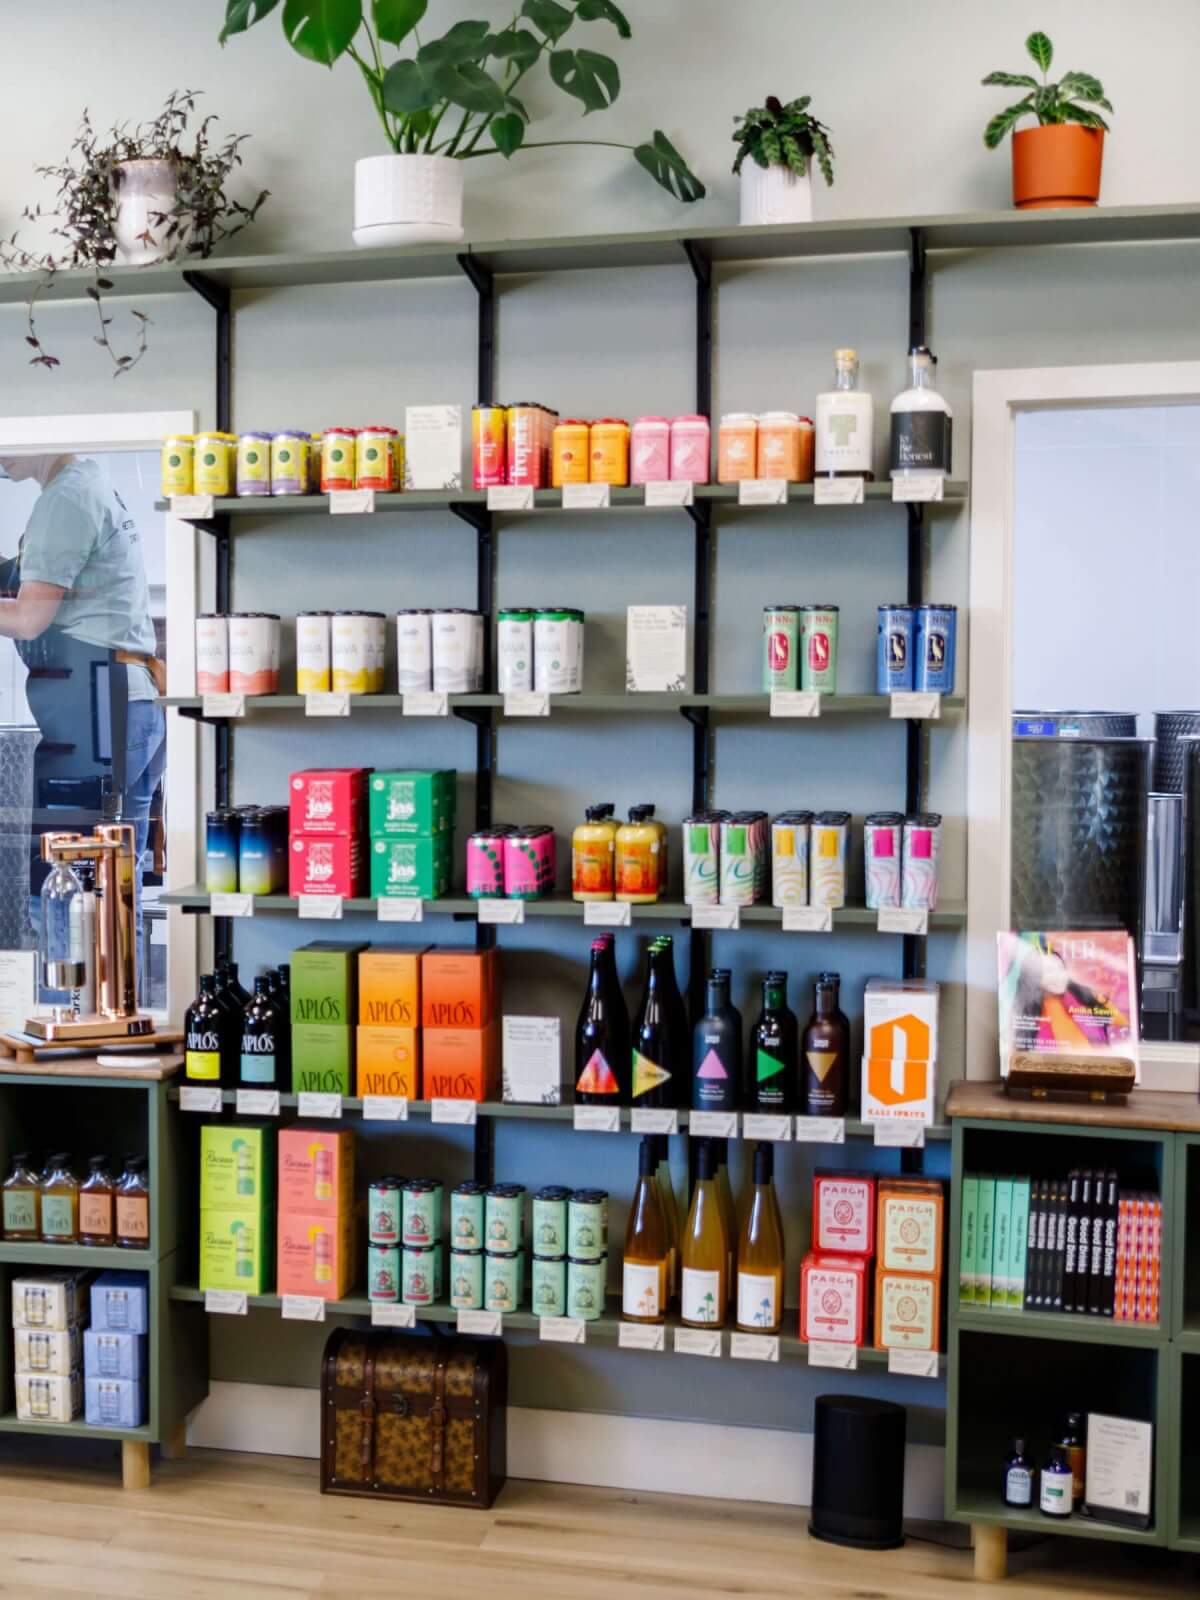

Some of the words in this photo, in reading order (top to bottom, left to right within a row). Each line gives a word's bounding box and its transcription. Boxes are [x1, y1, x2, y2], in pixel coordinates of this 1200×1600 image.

[1066, 1216, 1078, 1243] Good
[1079, 1217, 1090, 1244] Good
[1092, 1218, 1103, 1245] Good
[1105, 1220, 1115, 1247] Good
[1065, 1244, 1076, 1273] Drinks
[1078, 1245, 1088, 1274] Drinks
[1091, 1246, 1102, 1275] Drinks
[1103, 1248, 1115, 1276] Drinks
